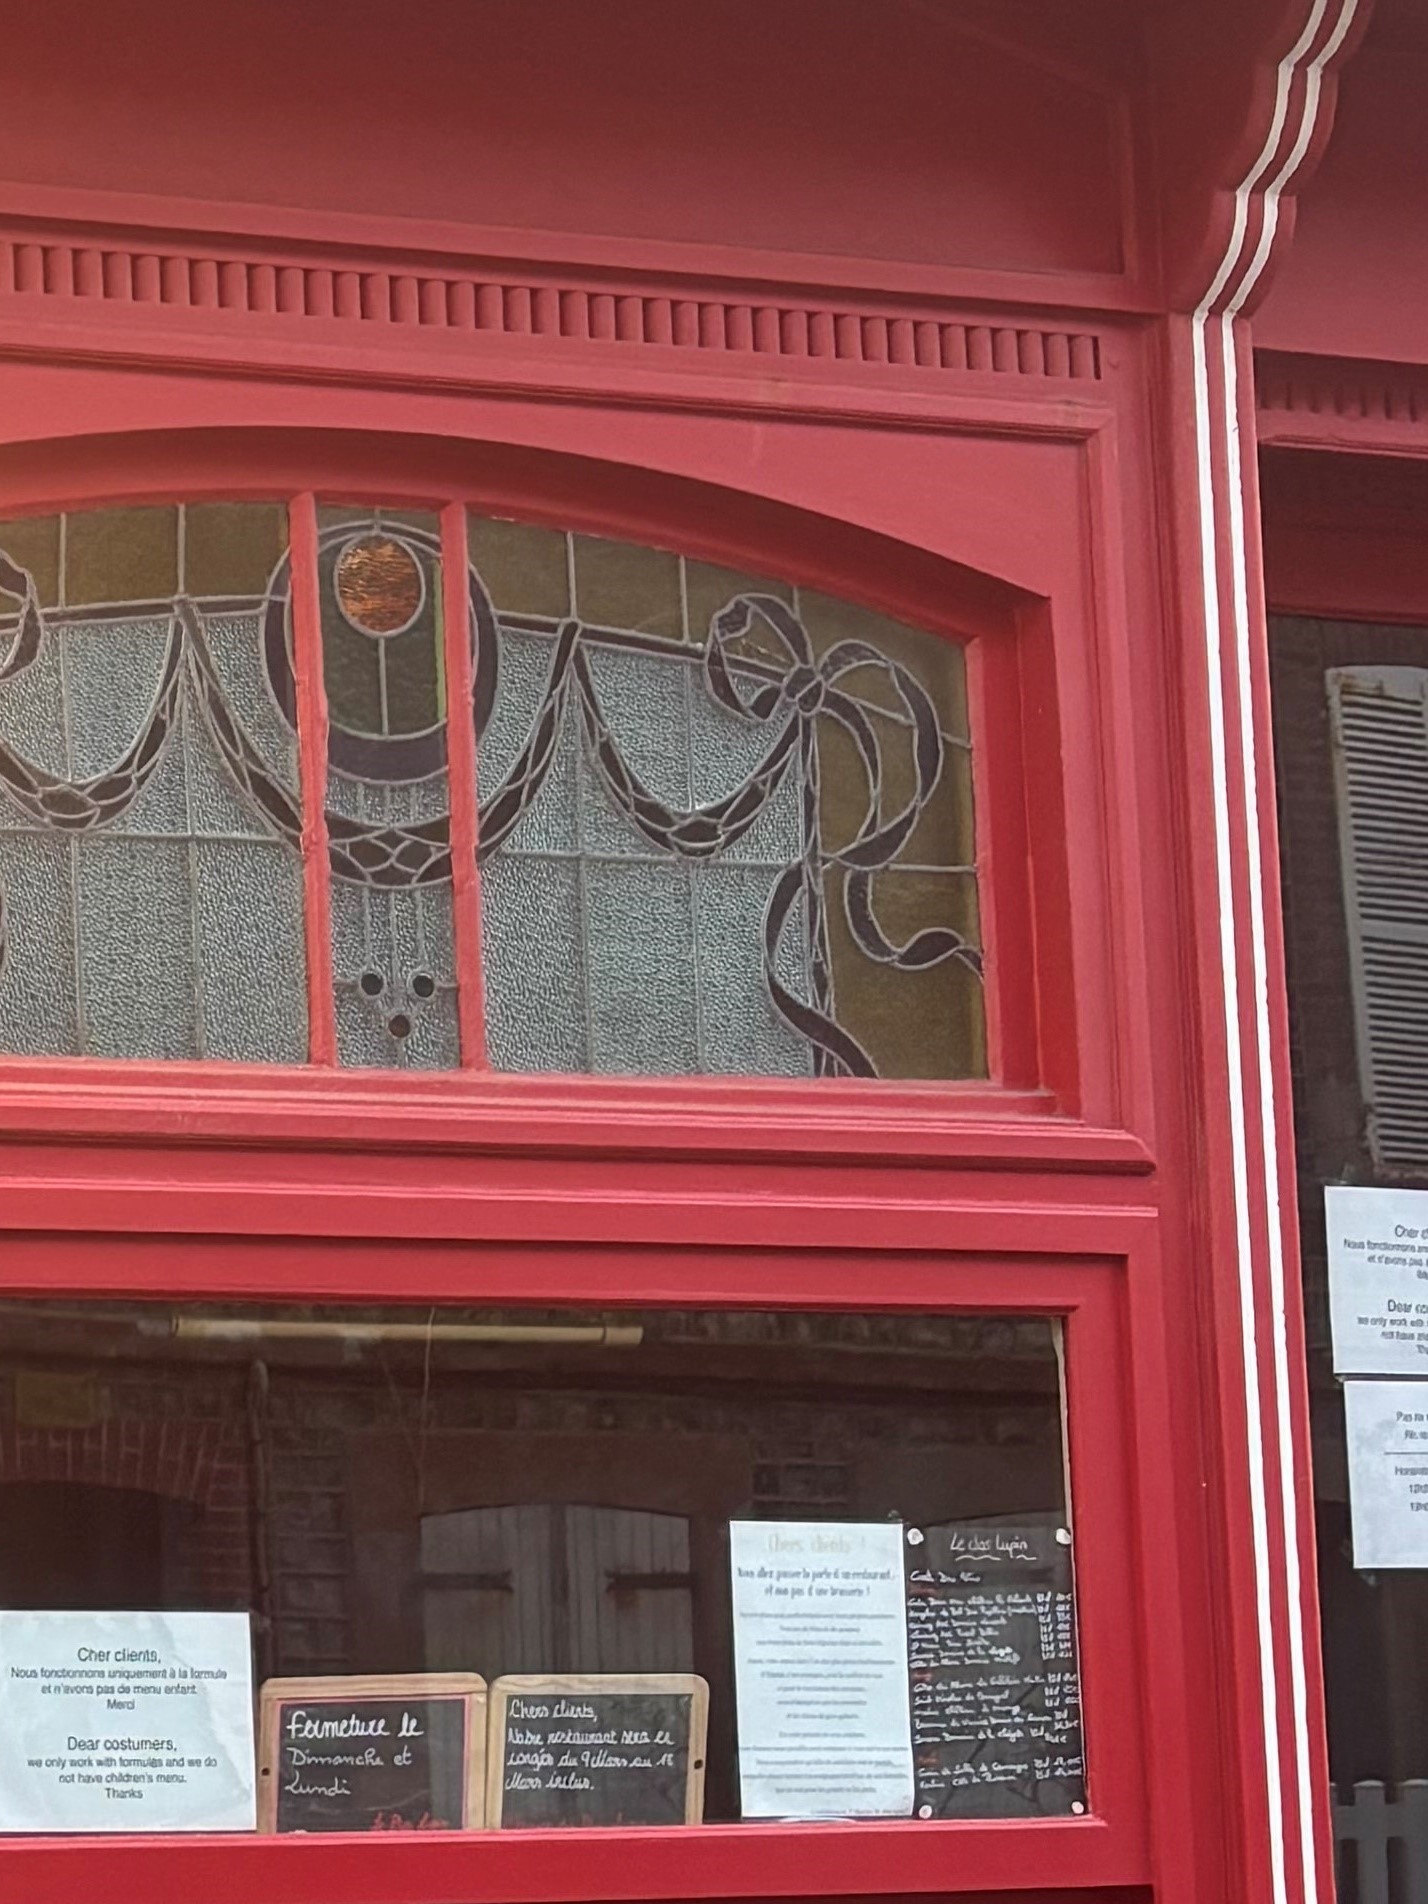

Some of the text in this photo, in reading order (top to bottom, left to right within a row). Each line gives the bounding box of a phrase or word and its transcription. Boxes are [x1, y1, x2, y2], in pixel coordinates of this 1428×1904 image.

[78, 1647, 115, 1663] Cher
[11, 1667, 38, 1679] Nous
[96, 1685, 115, 1697] pas
[397, 1712, 424, 1738] le
[67, 1736, 100, 1751] Dear
[286, 1745, 412, 1766] Dimanche et
[45, 1757, 66, 1770] only
[165, 1757, 184, 1767] and
[204, 1757, 218, 1767] do
[284, 1770, 351, 1796] Lundi
[105, 1787, 143, 1799] Thanks
